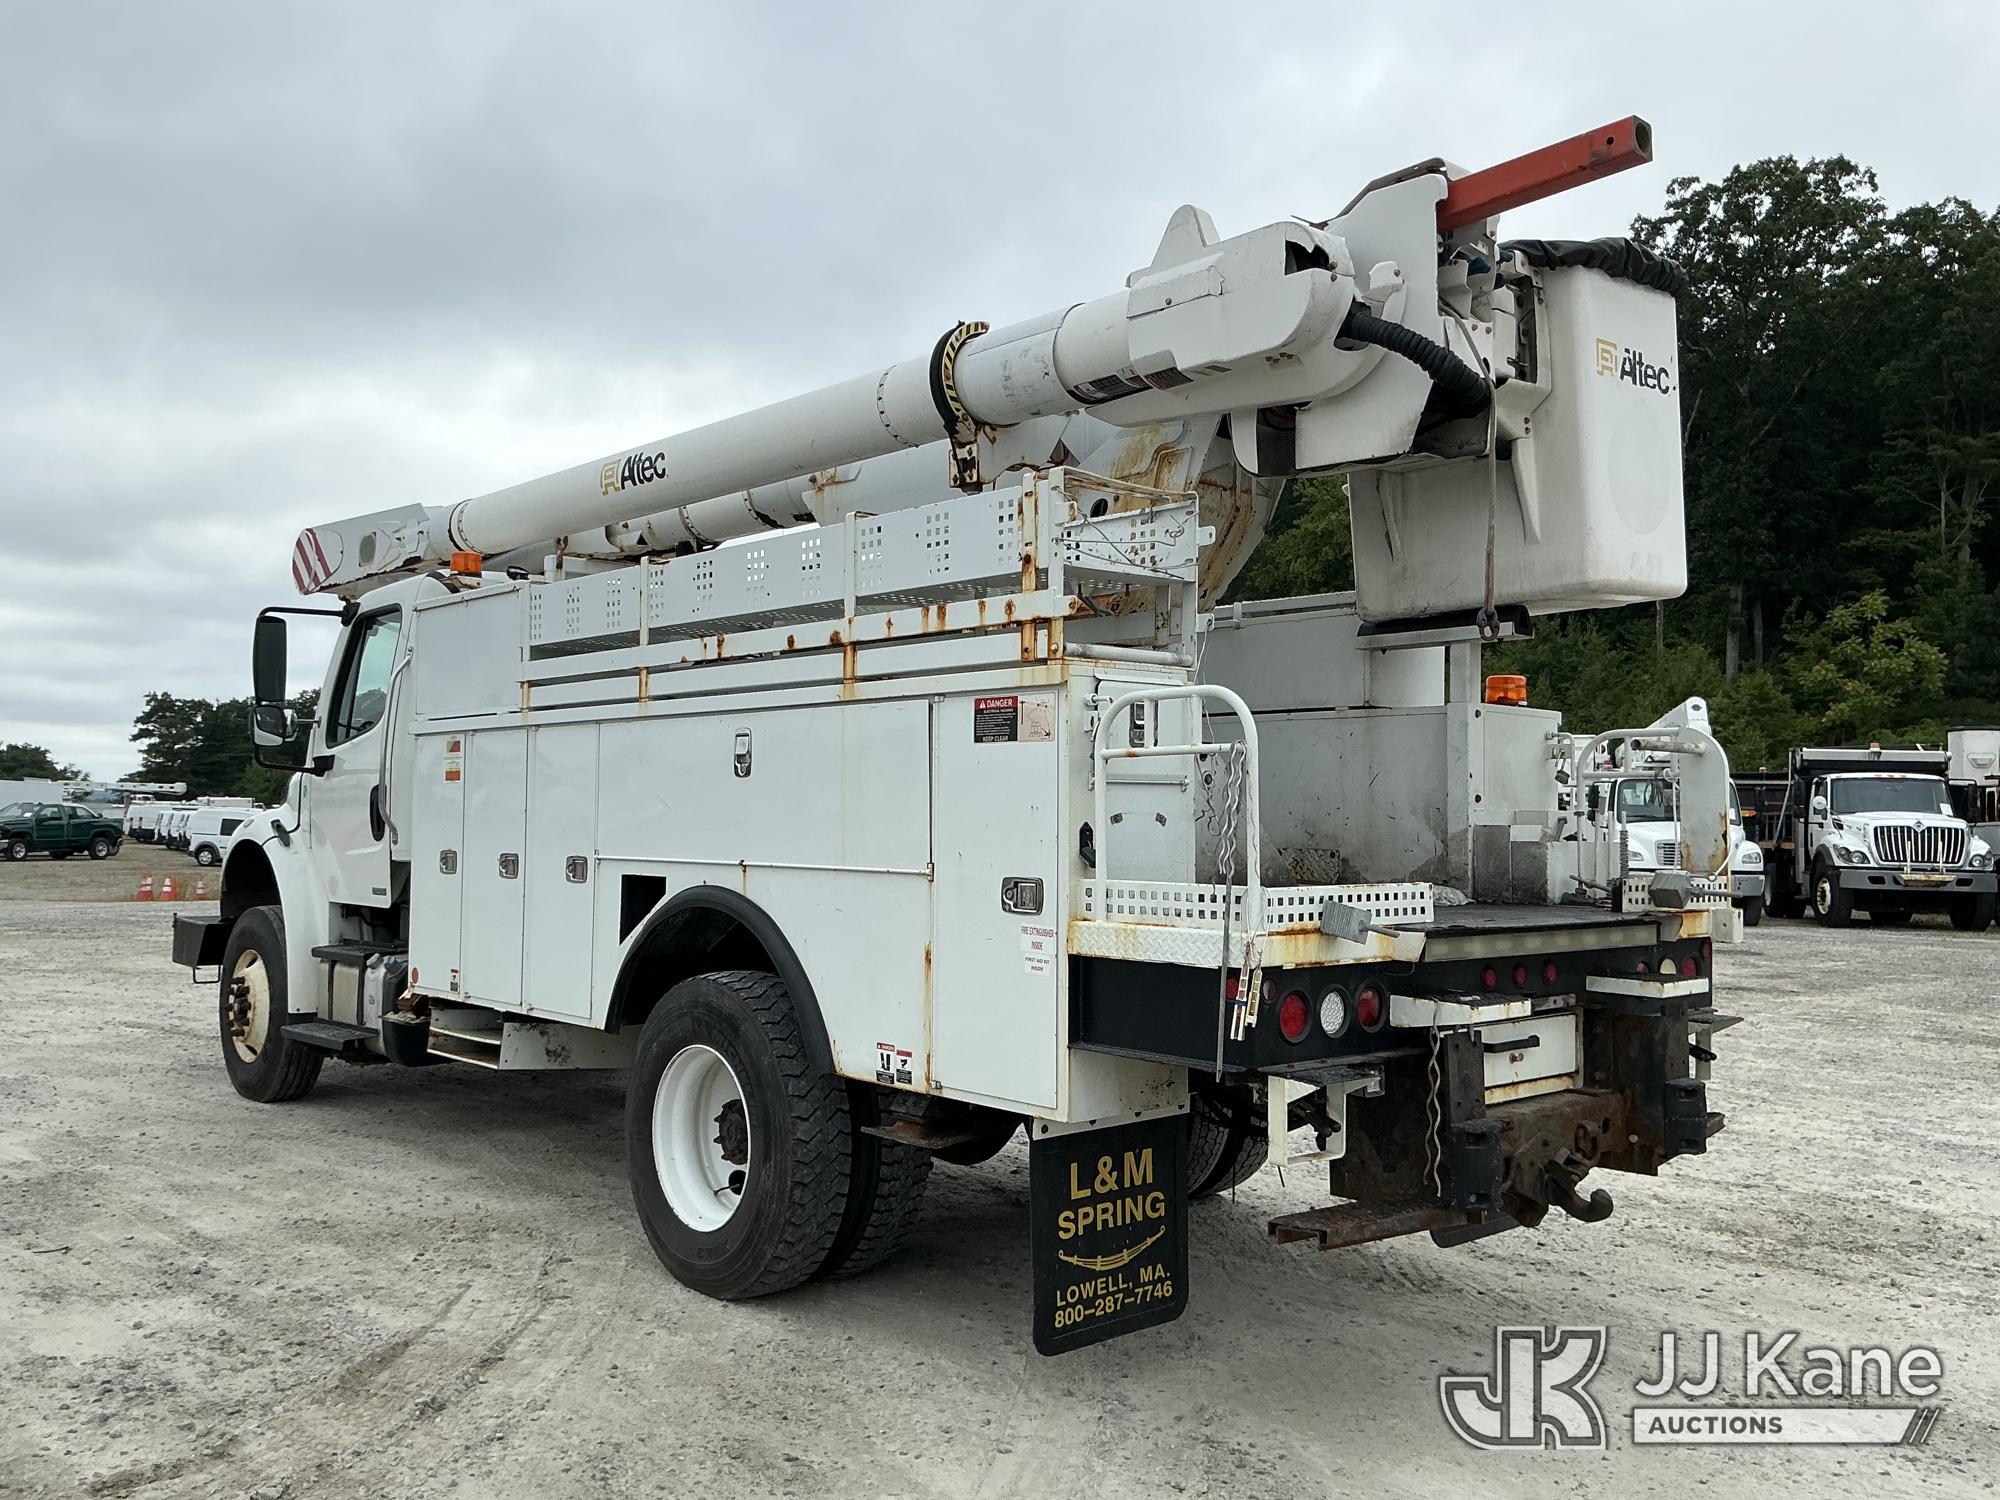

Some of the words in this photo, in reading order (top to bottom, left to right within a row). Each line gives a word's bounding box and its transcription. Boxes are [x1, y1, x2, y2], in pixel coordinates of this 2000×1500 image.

[1619, 347, 1670, 395] Altec
[620, 451, 667, 491] Altec
[986, 698, 1013, 708] DANGER
[1069, 1147, 1154, 1200] L&M
[1057, 1191, 1166, 1240] SPRING
[1054, 1280, 1174, 1329] 800-287-7746
[1056, 1272, 1134, 1308] LOWELL,
[1139, 1263, 1171, 1283] MA.
